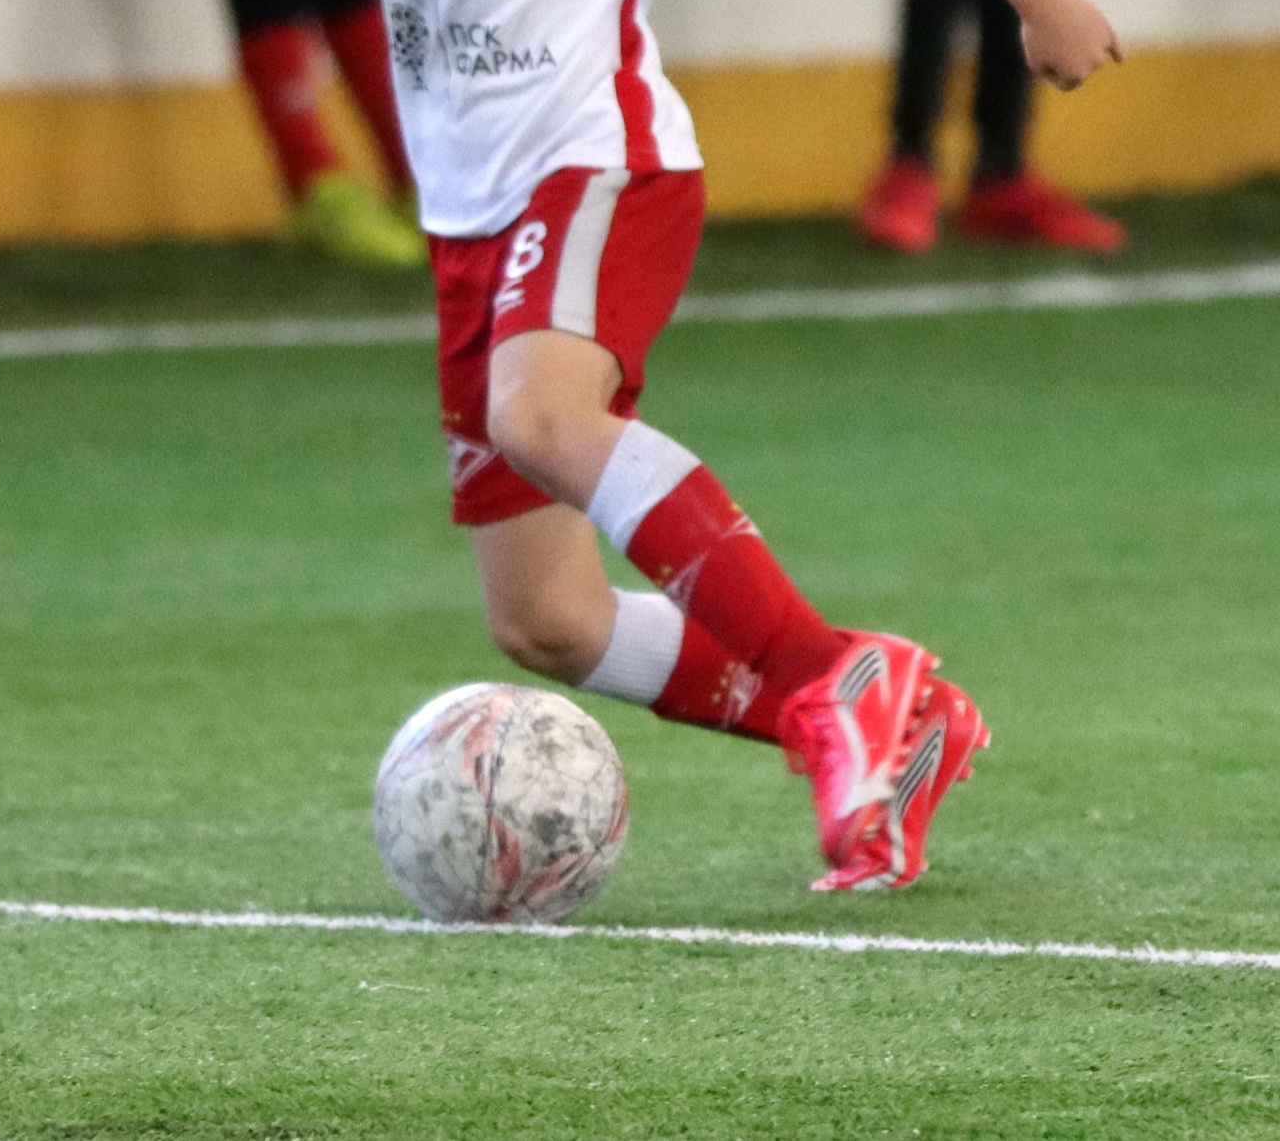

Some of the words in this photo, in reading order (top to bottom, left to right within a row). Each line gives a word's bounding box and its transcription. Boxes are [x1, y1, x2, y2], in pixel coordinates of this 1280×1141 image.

[450, 23, 502, 47] ПСК
[457, 43, 556, 76] САРМА
[506, 221, 548, 278] 8
